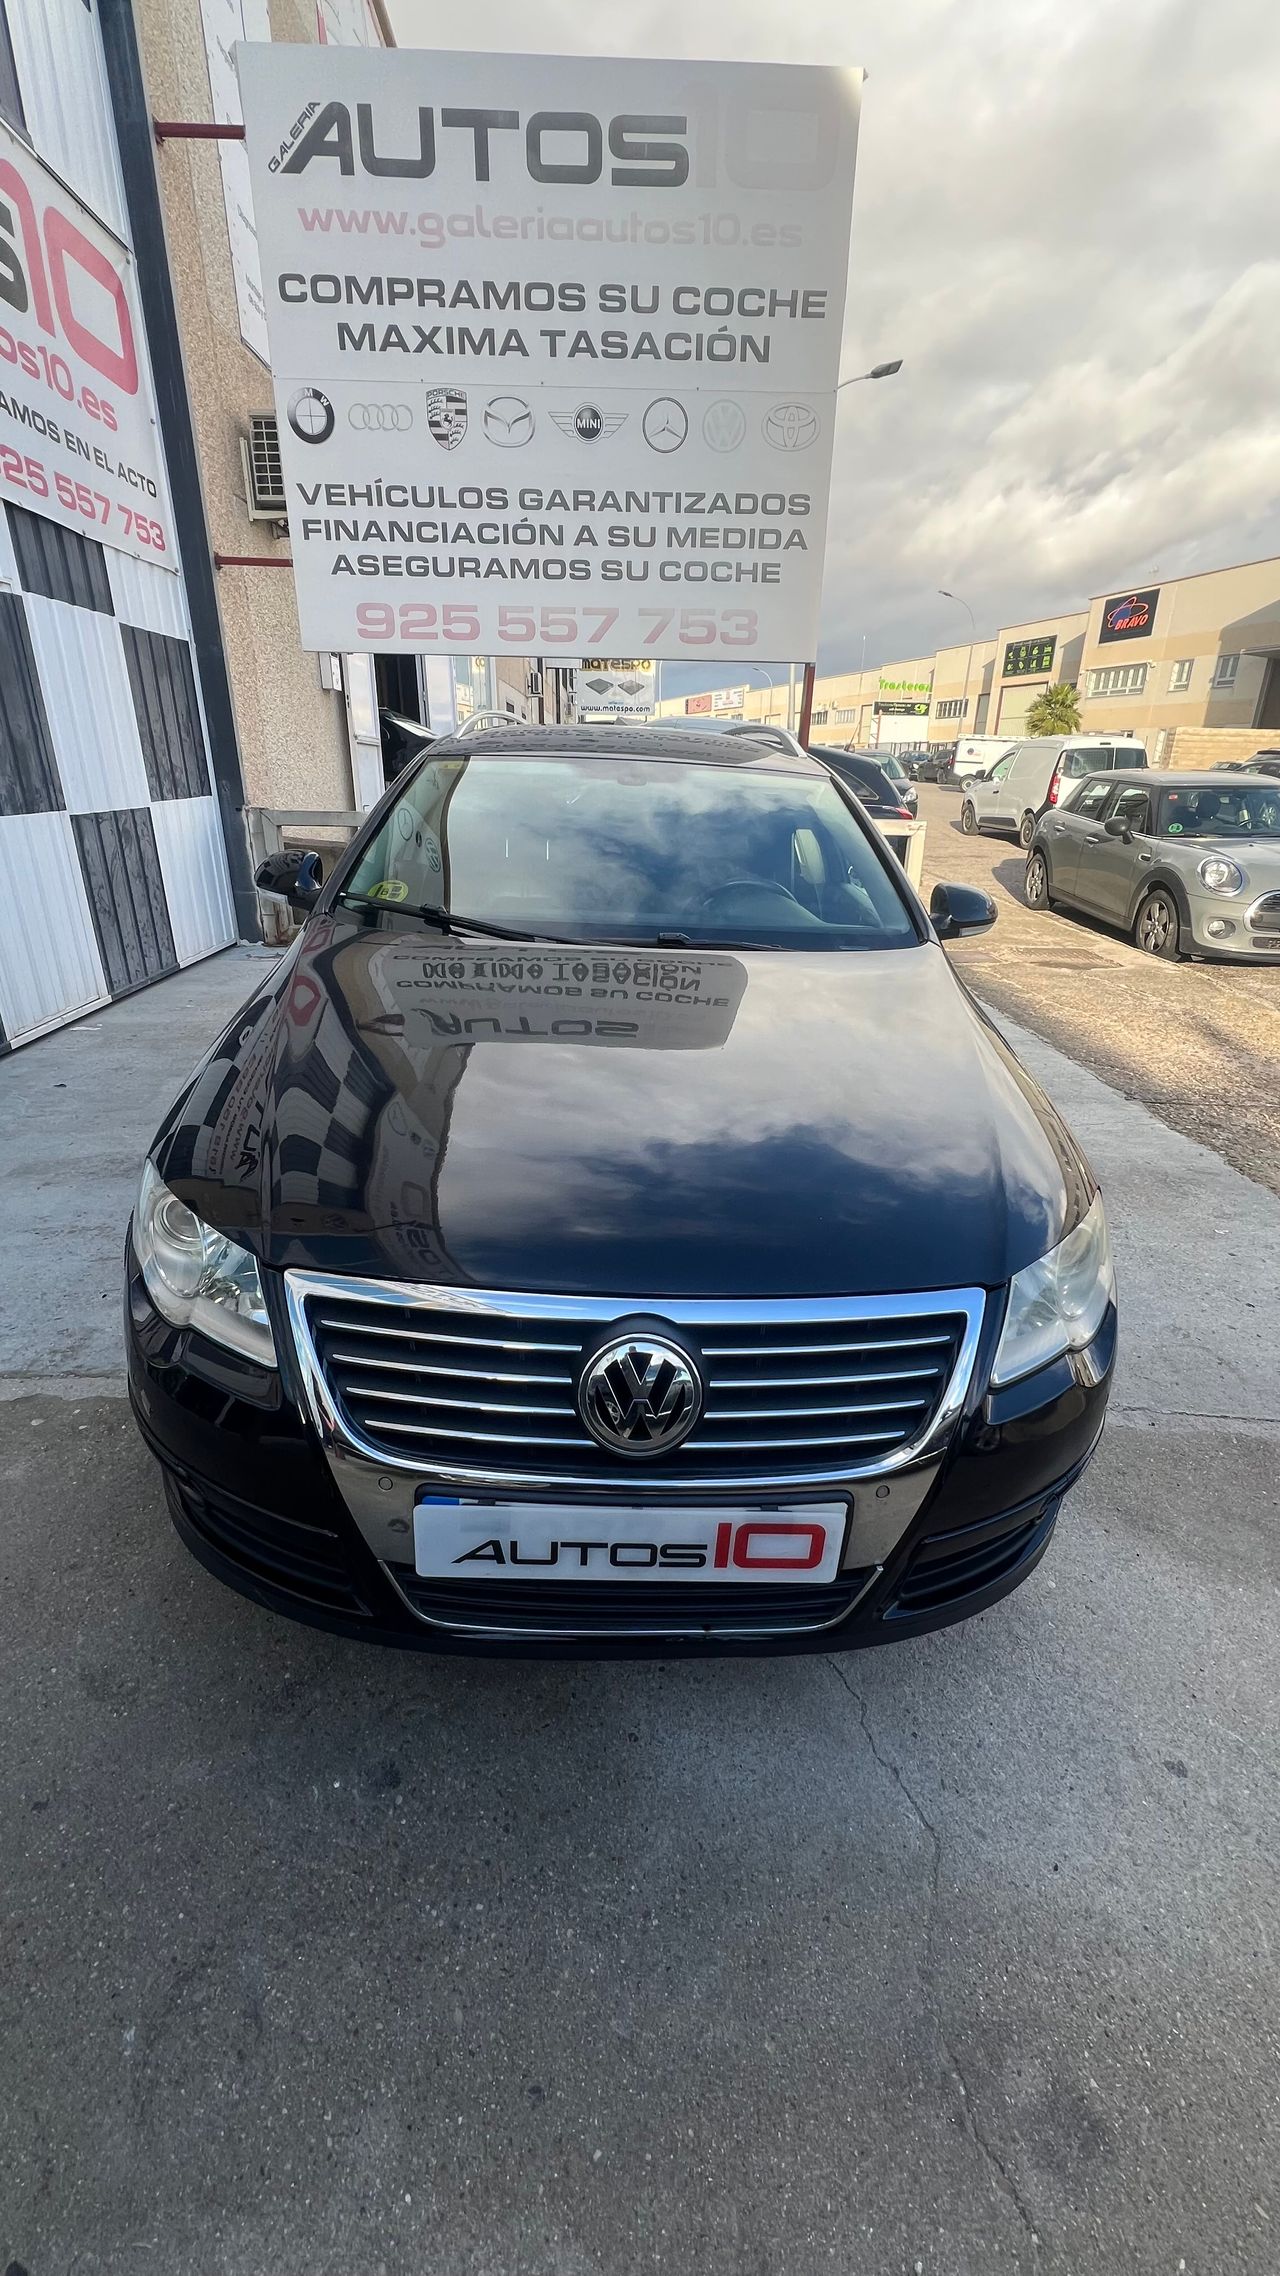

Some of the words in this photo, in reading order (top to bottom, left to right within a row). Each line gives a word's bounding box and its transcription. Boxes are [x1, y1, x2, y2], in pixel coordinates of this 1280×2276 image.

[268, 102, 321, 173] GALERIA
[297, 205, 803, 249] www.galeriaautos10.es
[278, 272, 586, 313] COMPRAMOS
[598, 283, 661, 315] SU
[672, 286, 828, 320] COCHE
[337, 322, 529, 357] MAXIMA
[541, 325, 771, 364] TASACIÓN
[577, 418, 601, 429] MINI
[64, 428, 91, 462] EN
[92, 446, 115, 475] EL
[117, 462, 158, 499] ACTO
[0, 443, 49, 498] 25
[54, 471, 111, 526] 557
[117, 503, 166, 552] 753
[296, 478, 508, 511] VEHÍCULOS
[518, 489, 811, 517] GARANTIZADOS
[302, 517, 565, 547] FINANCIACIÓN
[573, 524, 599, 548] A
[608, 525, 658, 549] SU
[667, 527, 809, 552] MEDIDA
[331, 555, 592, 582] ASEGURAMOS
[601, 558, 651, 582] SU
[659, 561, 782, 584] COCHE
[356, 602, 481, 642] 925
[497, 605, 619, 644] 557
[636, 608, 759, 646] 753
[1114, 614, 1149, 631] BRAVO
[580, 704, 651, 713] www.matespo.com
[451, 1522, 827, 1570] AUTOS10
